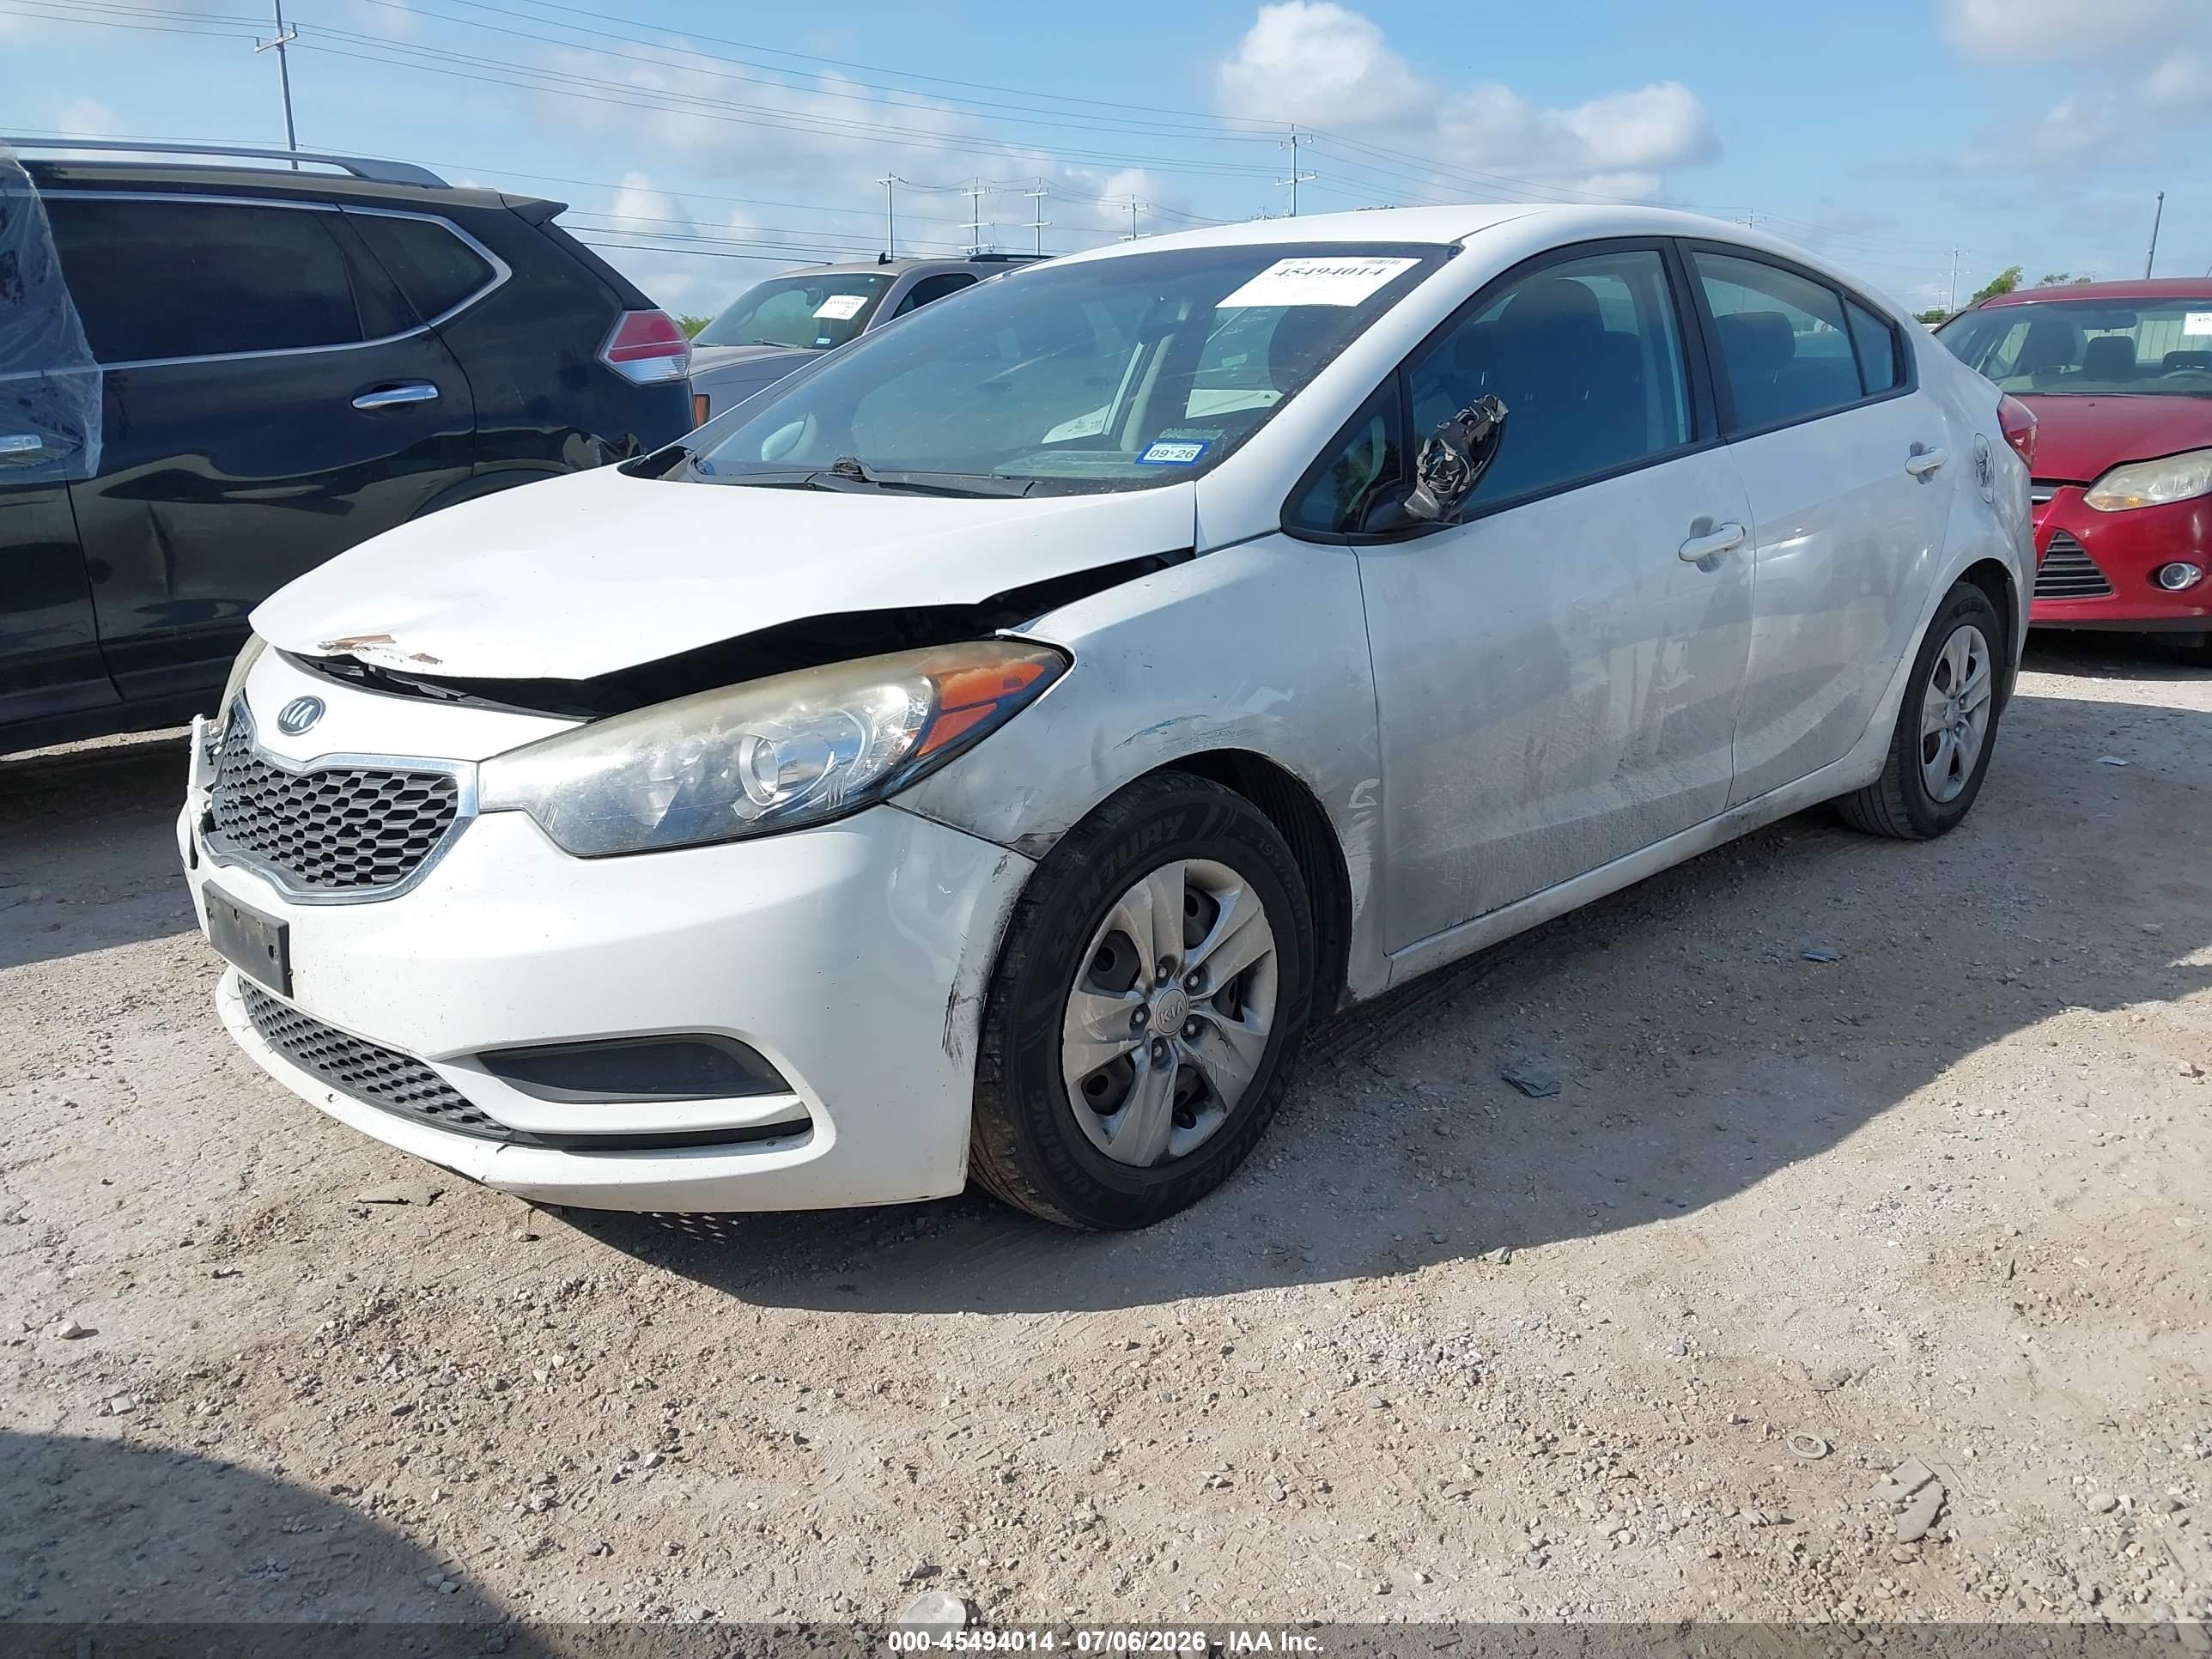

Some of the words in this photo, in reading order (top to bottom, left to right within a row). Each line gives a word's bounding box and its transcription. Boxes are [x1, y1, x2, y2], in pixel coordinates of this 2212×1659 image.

[1274, 266, 1389, 277] 45494014
[1149, 449, 1170, 459] 09
[1174, 449, 1196, 459] 26
[280, 700, 315, 728] KIA
[1159, 1000, 1184, 1024] KIA
[1029, 1089, 1105, 1202] TOURING
